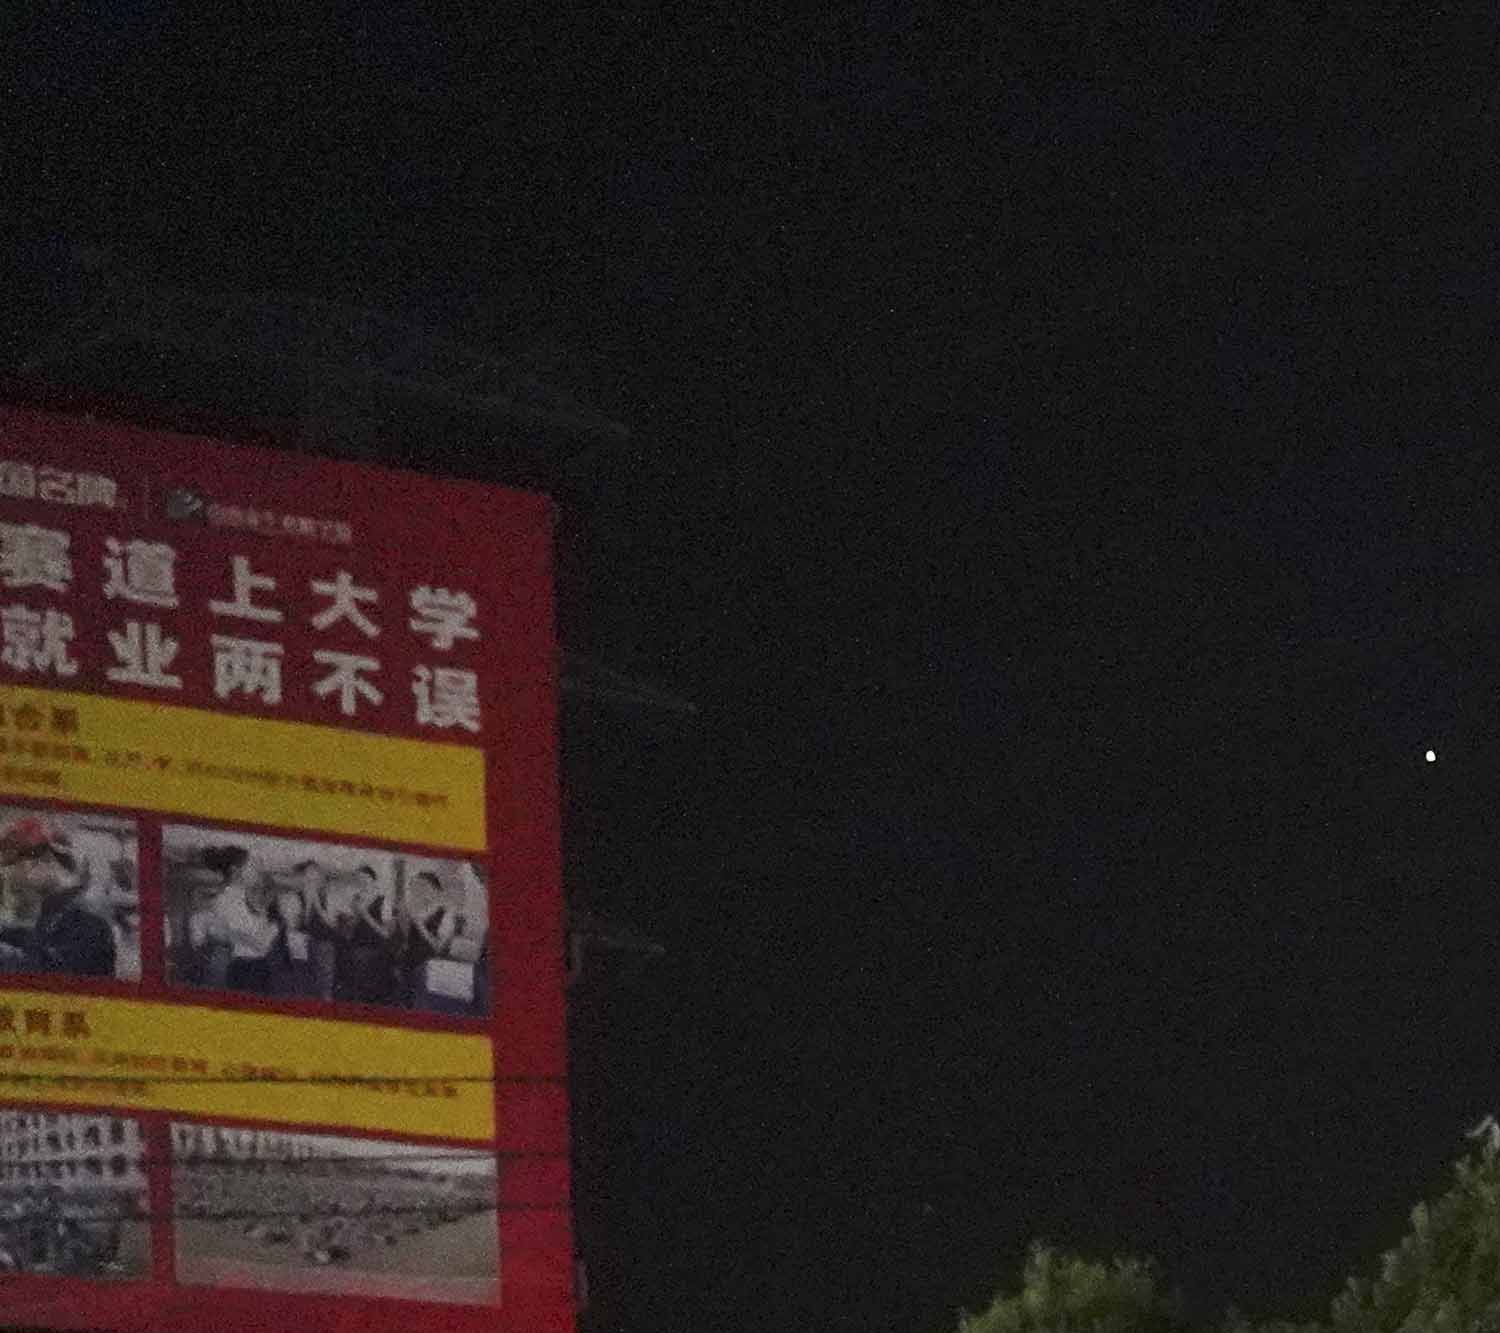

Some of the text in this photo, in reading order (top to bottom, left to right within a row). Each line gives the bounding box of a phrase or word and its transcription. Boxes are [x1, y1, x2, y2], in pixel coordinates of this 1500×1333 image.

[0, 601, 482, 735] 就业两不误
